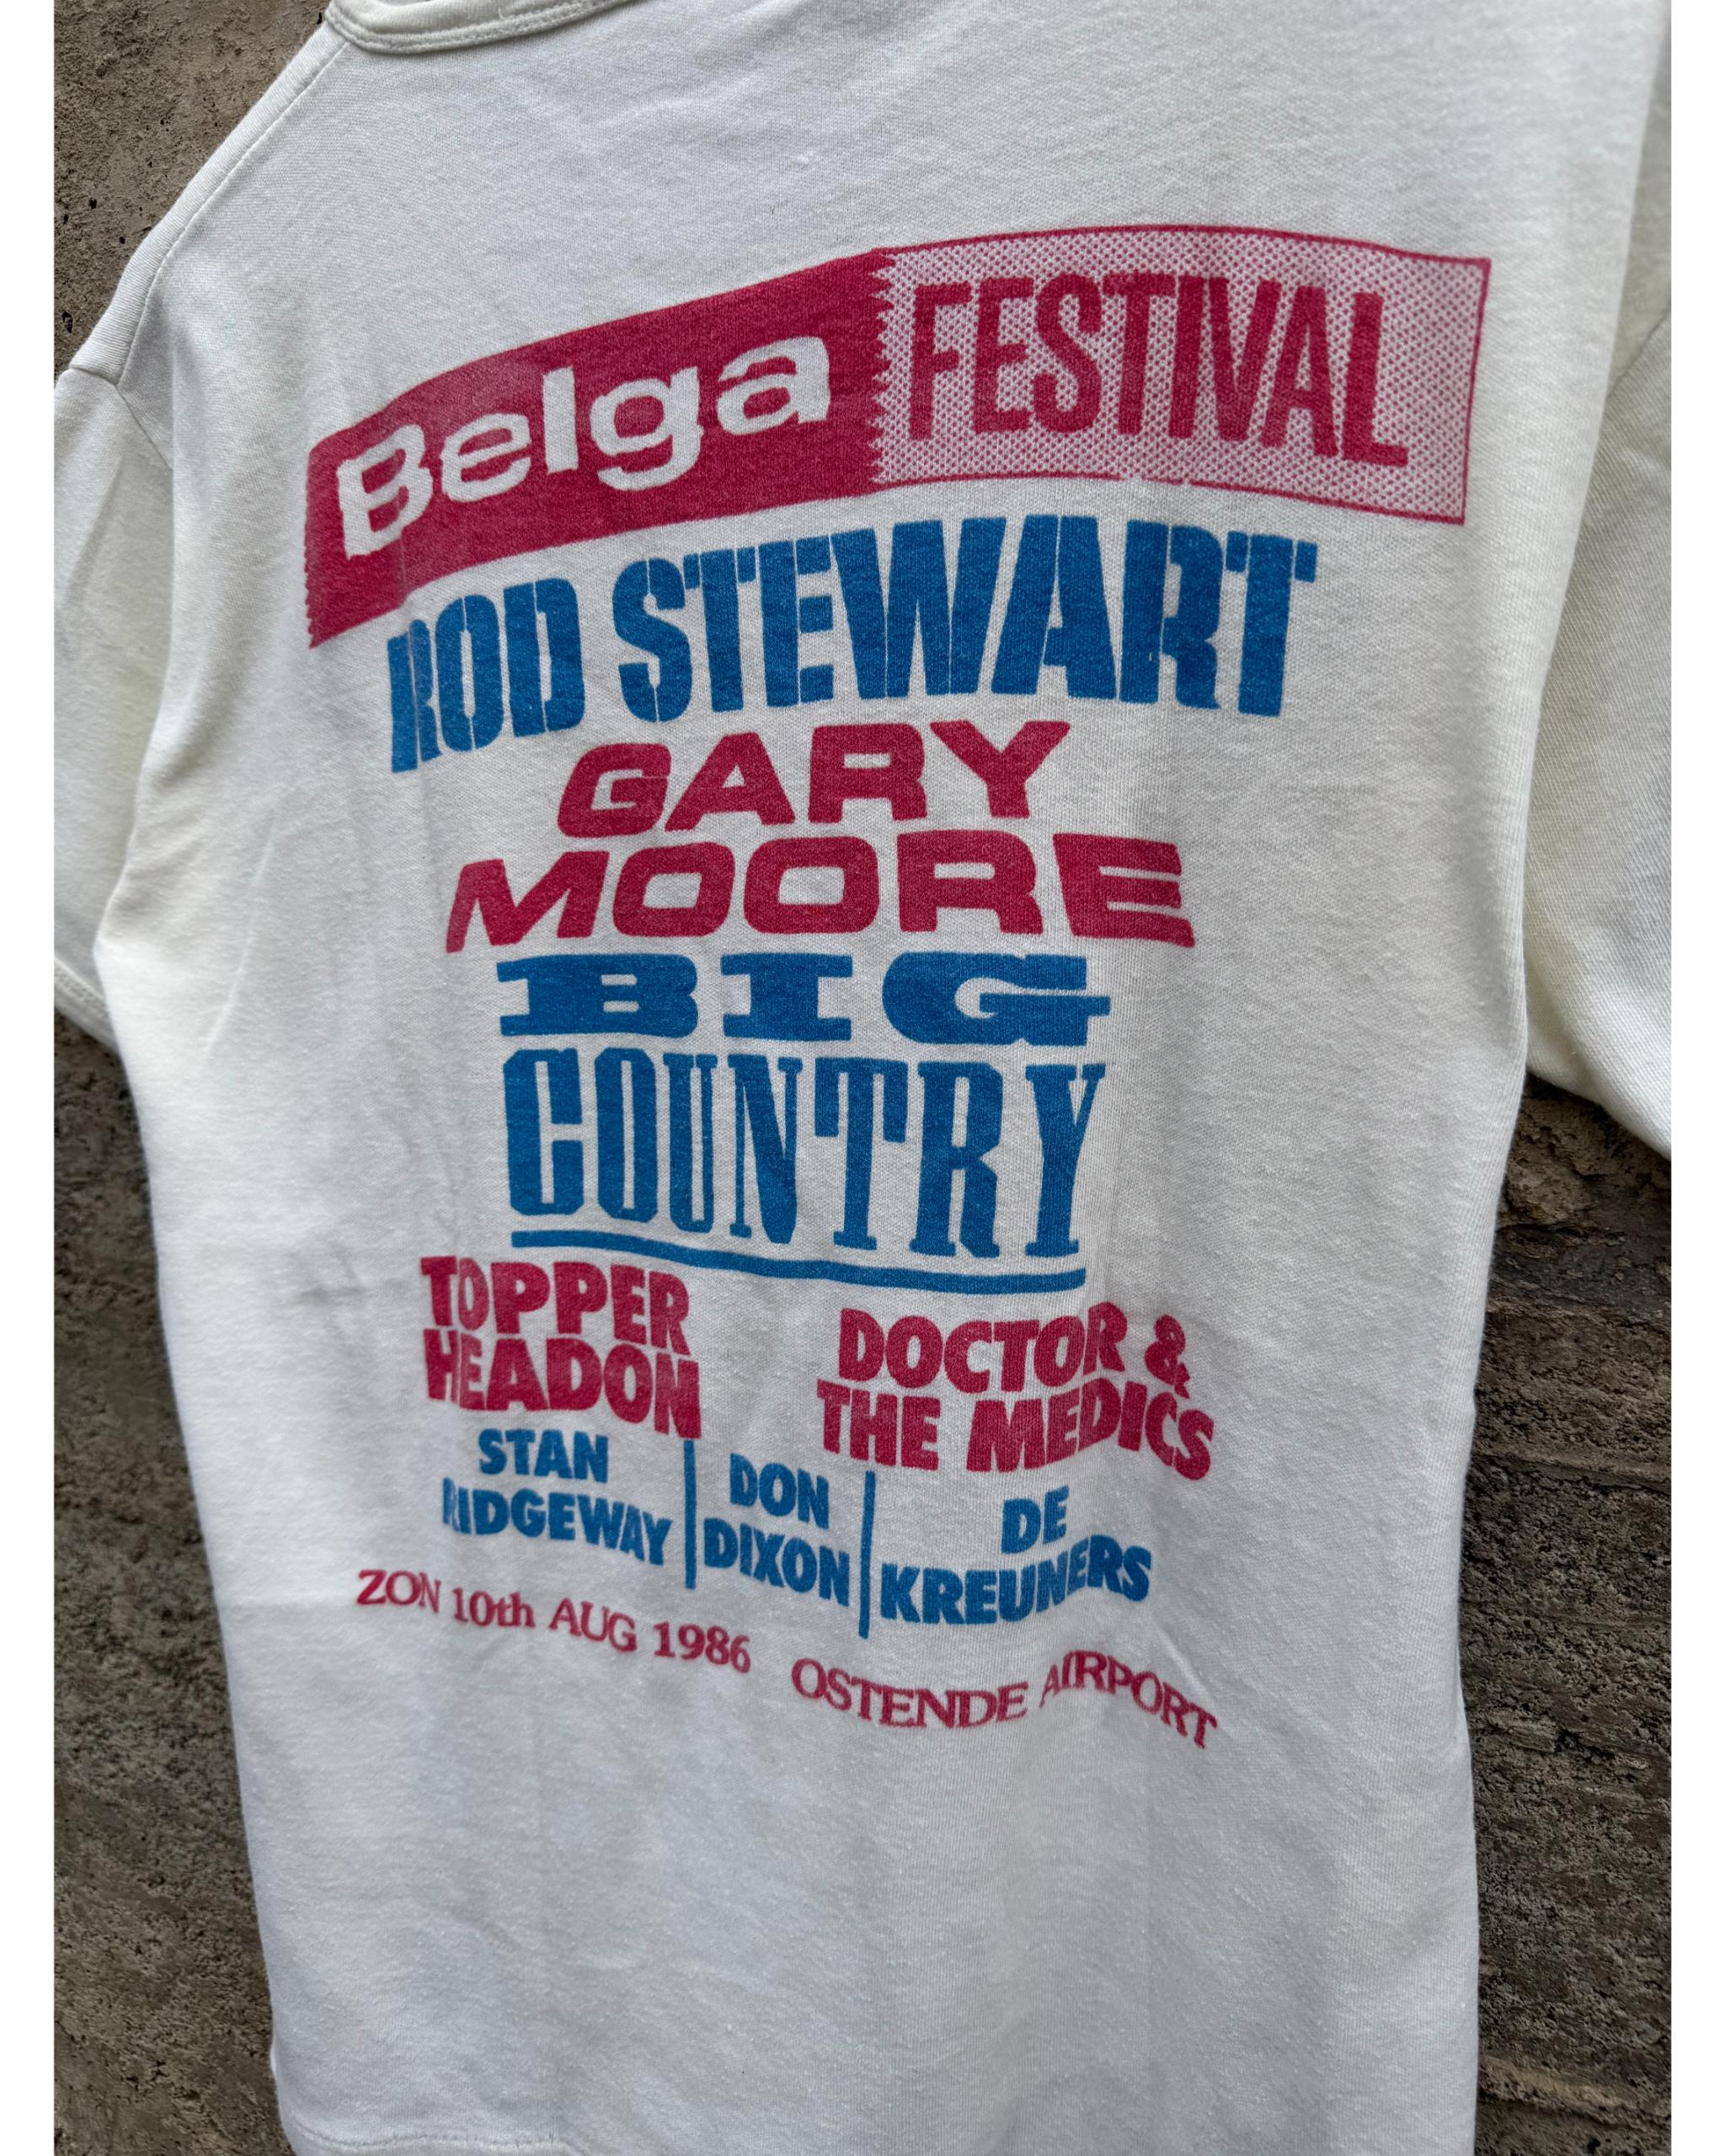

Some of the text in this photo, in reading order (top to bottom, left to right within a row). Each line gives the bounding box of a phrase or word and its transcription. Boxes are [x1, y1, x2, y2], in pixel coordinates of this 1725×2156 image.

[337, 270, 1410, 559] Belga FESTIVAL
[387, 515, 1318, 773] ROD STEWART
[557, 720, 1071, 839] GARY
[446, 829, 1196, 953] MOORE
[496, 951, 1111, 1047] BIG
[502, 1046, 1107, 1260] COUNTRY
[420, 1256, 692, 1356] TOPPER
[838, 1301, 1190, 1400] DOCTOR &
[424, 1329, 702, 1439] HEADON
[816, 1378, 1214, 1481] THE MEDICS
[478, 1428, 608, 1484] STAN
[729, 1453, 830, 1529] DON
[441, 1477, 672, 1566] RIDGEWAY
[703, 1517, 850, 1607] DIXON
[1001, 1485, 1070, 1554] DE
[879, 1534, 1152, 1625] KREUNERS
[356, 1570, 1218, 1749] ZON 10th AUG 1986 OSTENDE AIRPORT
